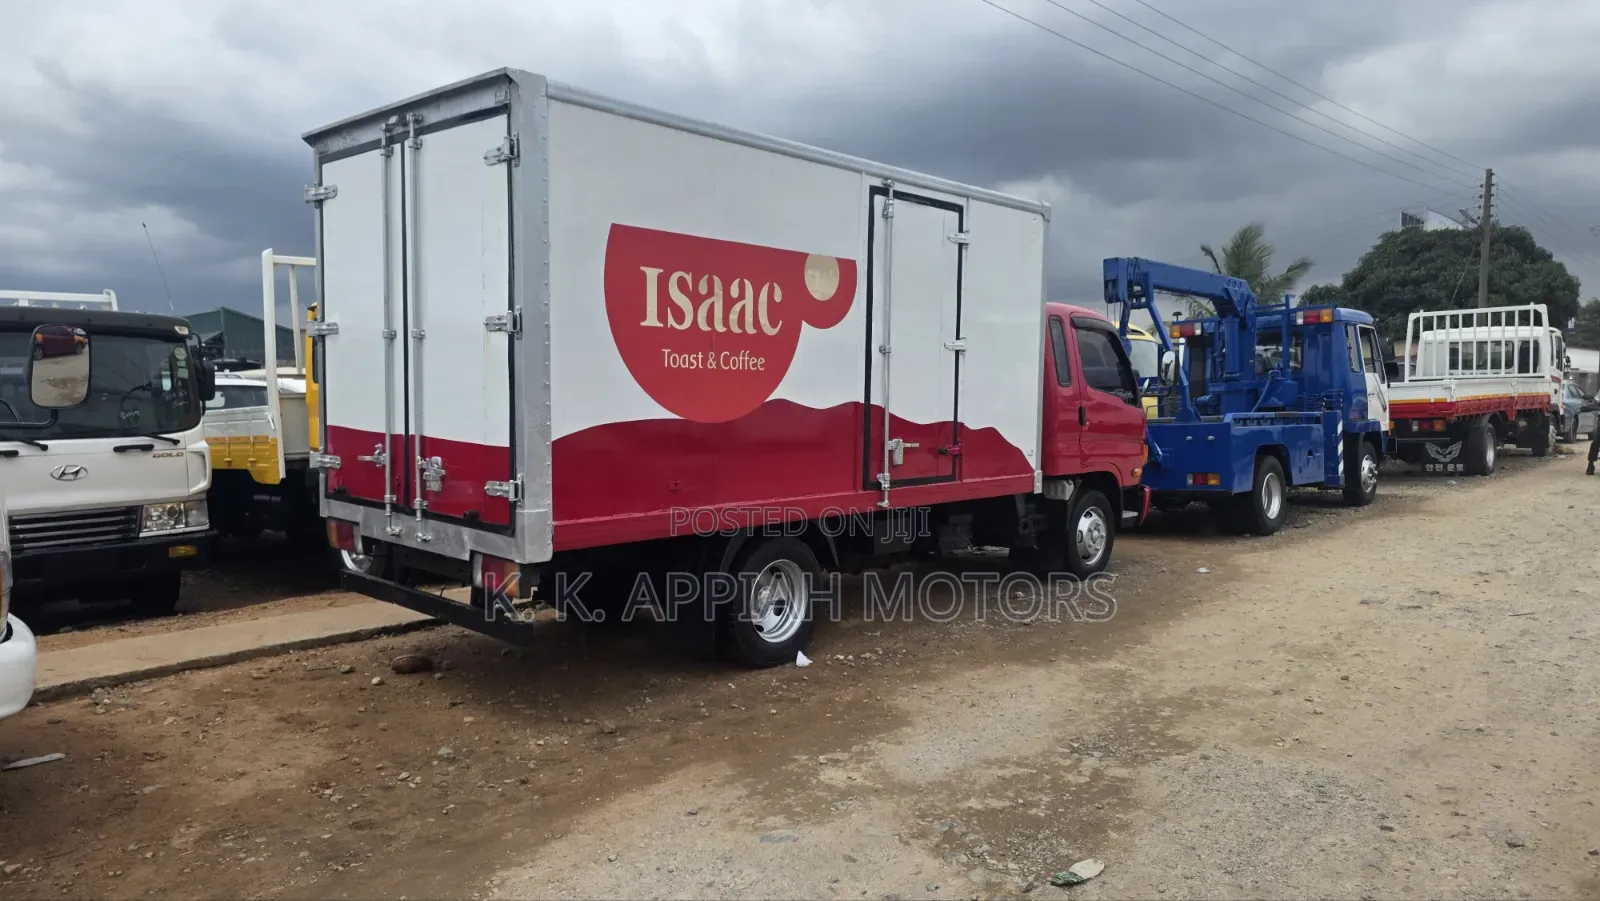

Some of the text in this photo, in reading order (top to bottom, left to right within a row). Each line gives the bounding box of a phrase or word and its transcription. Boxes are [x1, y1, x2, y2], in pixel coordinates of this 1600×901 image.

[639, 265, 783, 336] Isaac
[661, 348, 766, 371] Toast & Coffee
[1425, 463, 1443, 472] 안전
